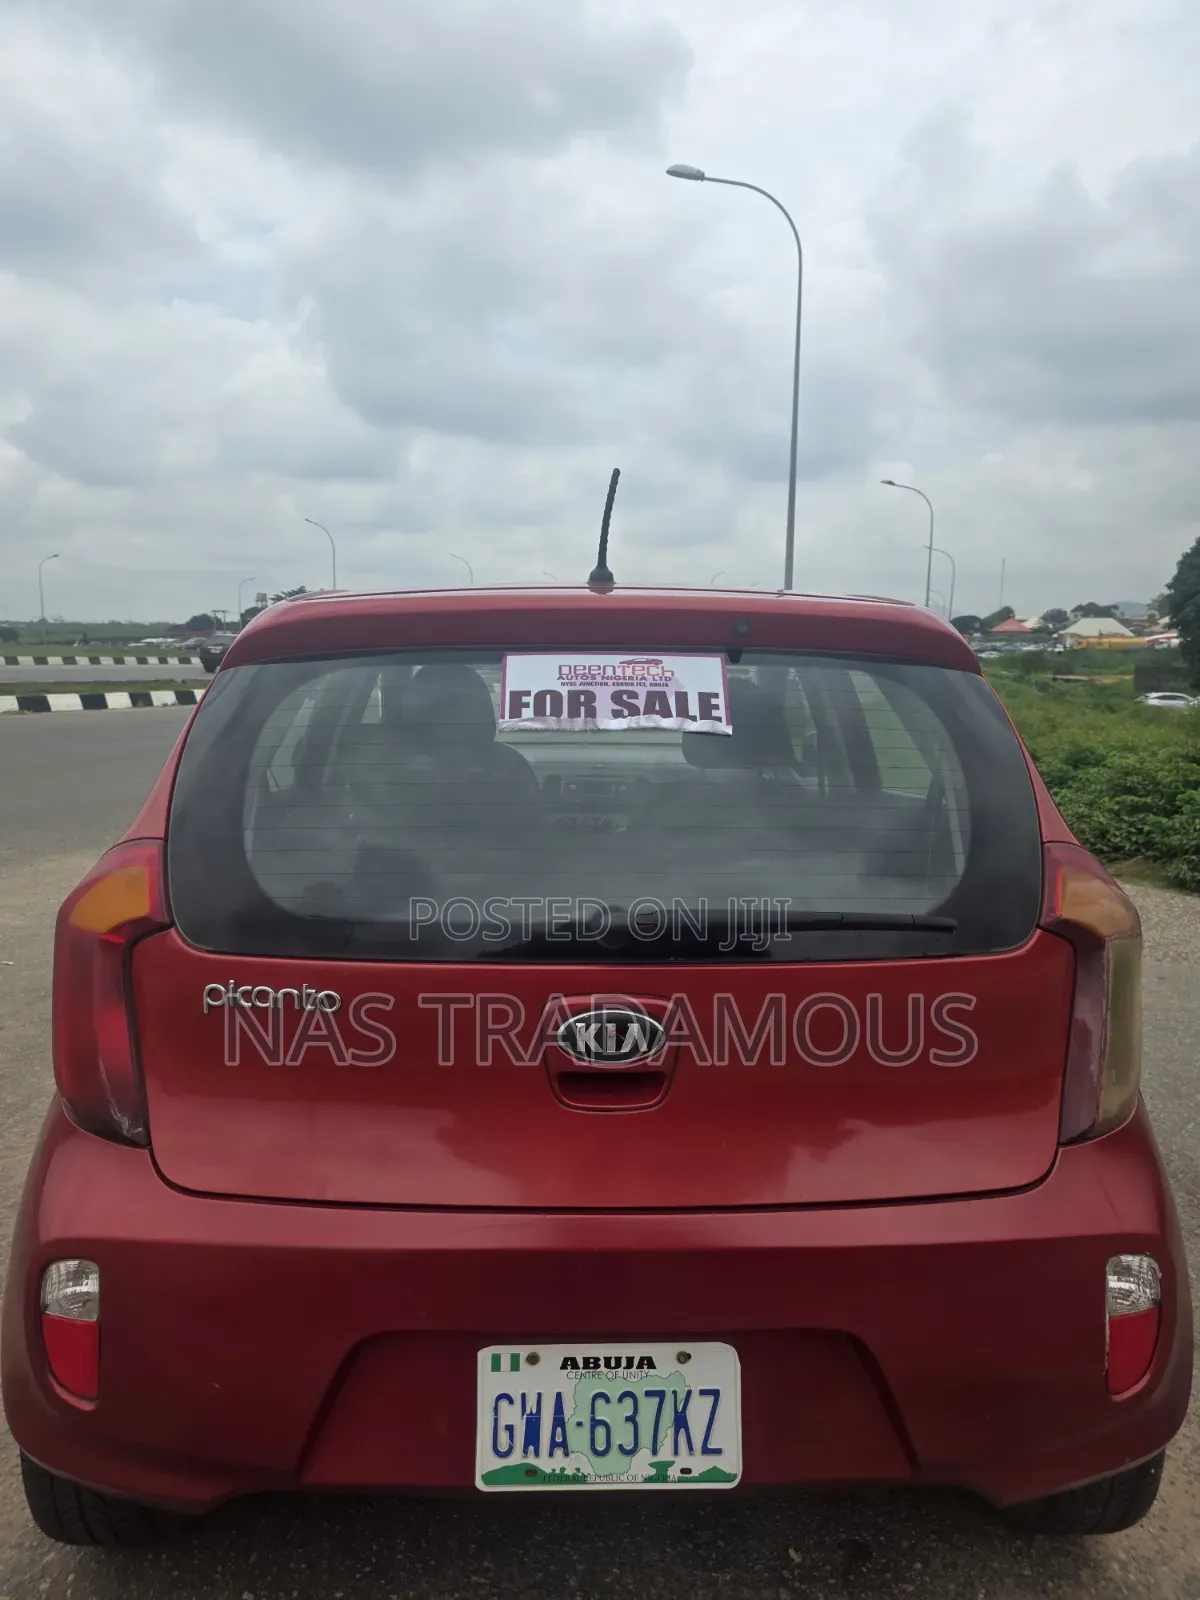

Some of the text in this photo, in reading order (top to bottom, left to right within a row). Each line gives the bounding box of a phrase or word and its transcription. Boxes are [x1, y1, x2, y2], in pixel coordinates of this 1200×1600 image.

[601, 674, 648, 682] NIGERIA
[509, 690, 723, 723] FOR SALE
[203, 979, 342, 1015] picanto
[575, 1022, 648, 1053] KIA
[559, 1356, 657, 1371] ABUJA
[566, 1370, 650, 1380] CENTRE OF UNITY
[491, 1388, 723, 1459] GWA-637KZ
[543, 1474, 581, 1483] FEDERAL
[583, 1473, 626, 1483] REPUBLIC
[626, 1473, 639, 1482] OF
